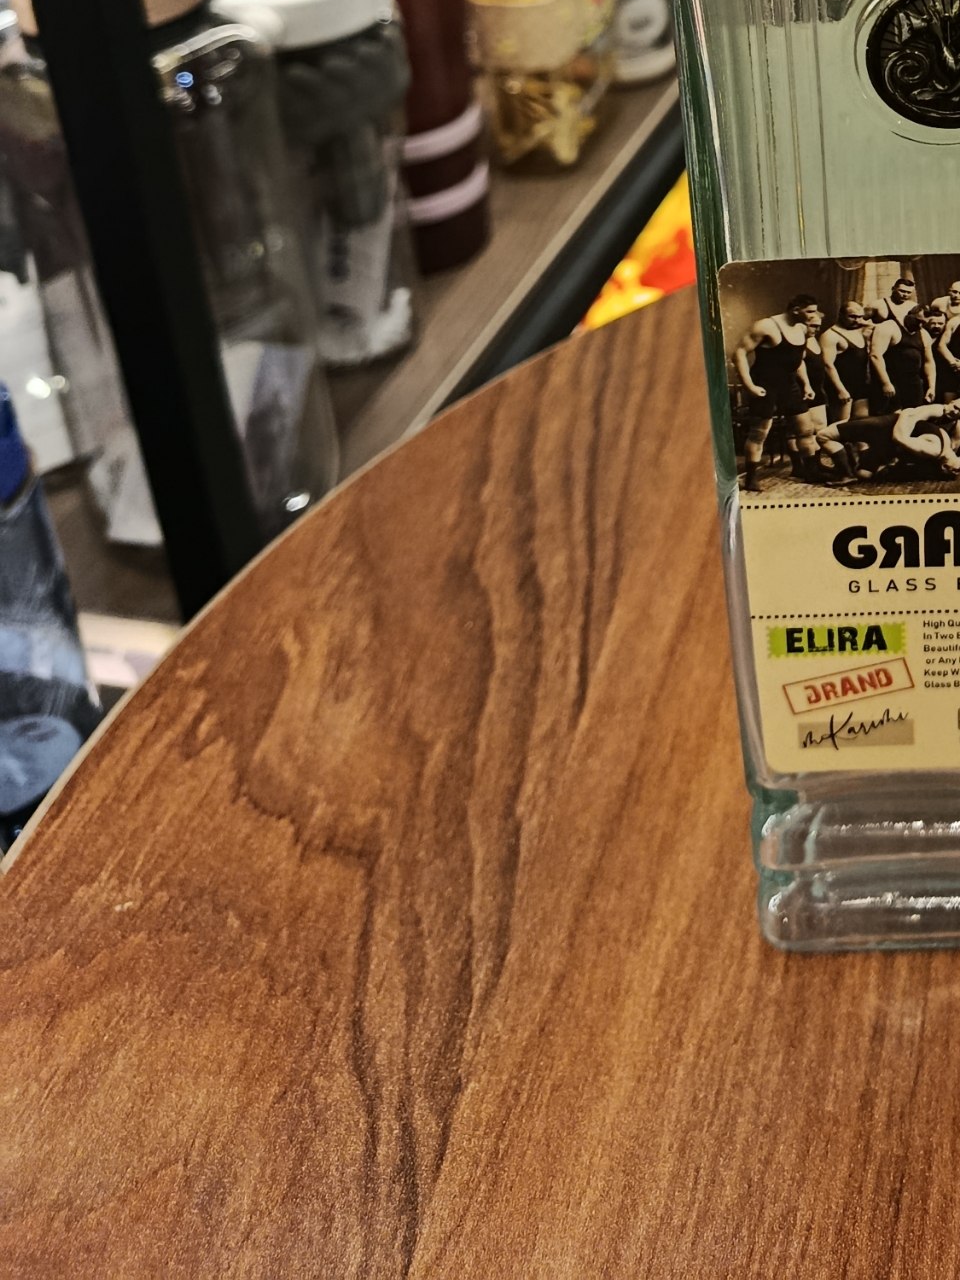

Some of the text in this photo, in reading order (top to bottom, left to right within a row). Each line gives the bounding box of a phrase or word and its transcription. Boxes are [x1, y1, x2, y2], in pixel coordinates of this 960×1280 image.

[848, 577, 937, 594] GLASS
[922, 619, 946, 630] High
[786, 625, 888, 653] ELIRA
[922, 631, 933, 641] In
[934, 632, 955, 640] Two
[938, 656, 957, 666] Any
[923, 668, 949, 678] Keep
[923, 680, 952, 689] Glass
